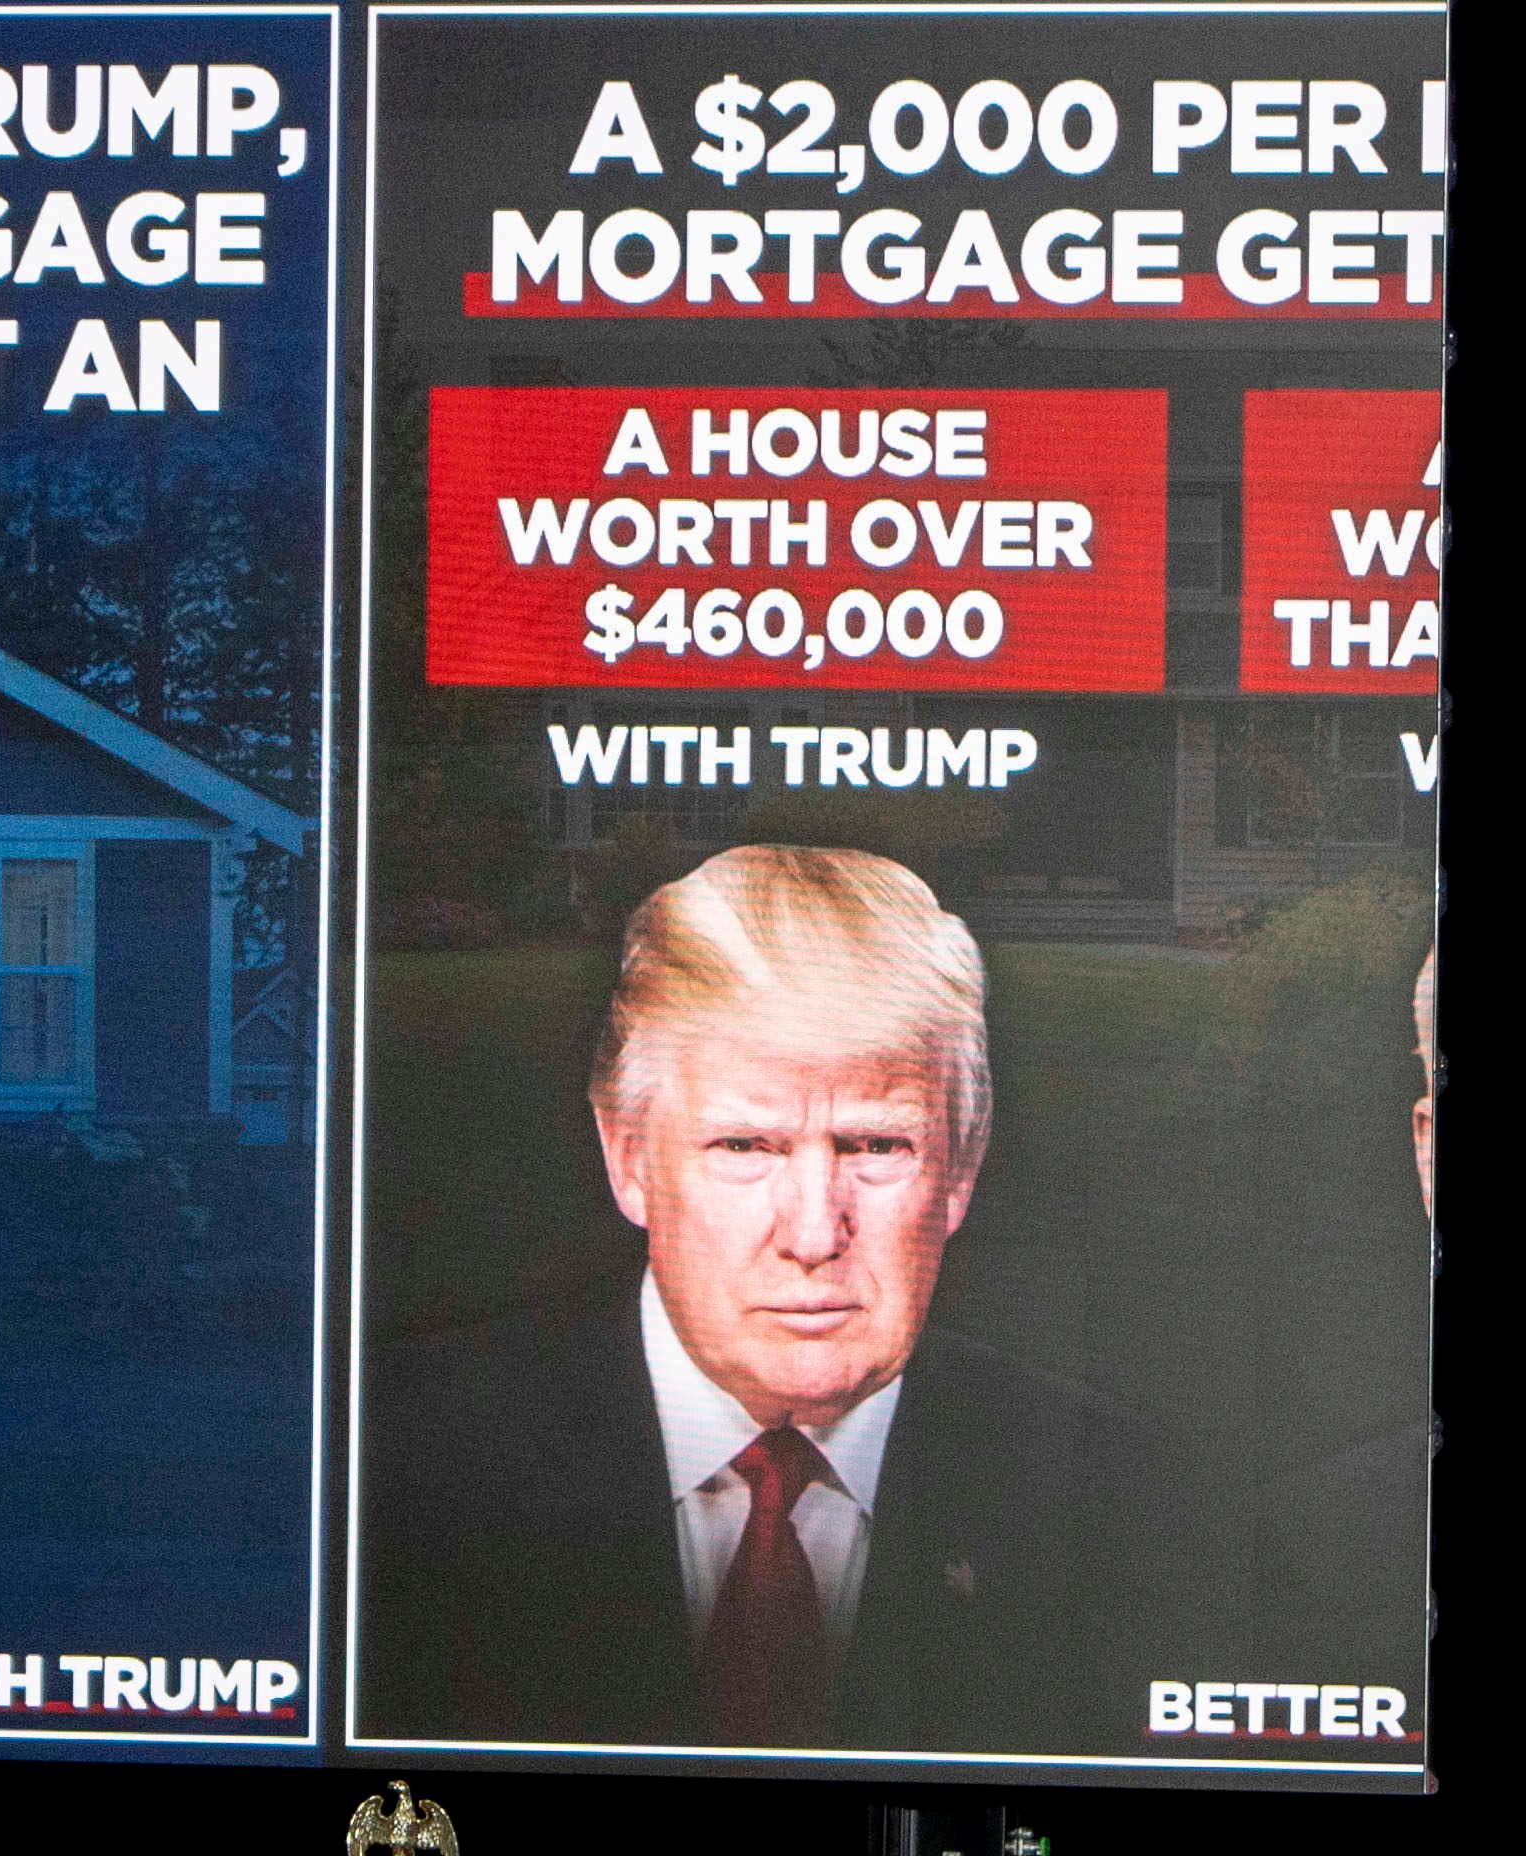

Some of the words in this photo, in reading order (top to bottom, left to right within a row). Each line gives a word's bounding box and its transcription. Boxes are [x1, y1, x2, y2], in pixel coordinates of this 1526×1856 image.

[567, 80, 665, 175] A
[690, 73, 1120, 195] $2,000
[1151, 79, 1389, 175] PER
[490, 207, 1185, 306] MORTGAGE
[1214, 207, 1445, 306] GET
[42, 317, 222, 412] AN
[602, 407, 671, 476] A
[690, 407, 988, 479] HOUSE
[496, 496, 829, 567] WORTH
[849, 498, 1094, 569] OVER
[582, 582, 1005, 671] $460,000
[546, 724, 752, 786] WITH
[768, 725, 1039, 789] TRUMP
[58, 1654, 301, 1714] TRUMP
[1148, 1680, 1408, 1739] BETTER
